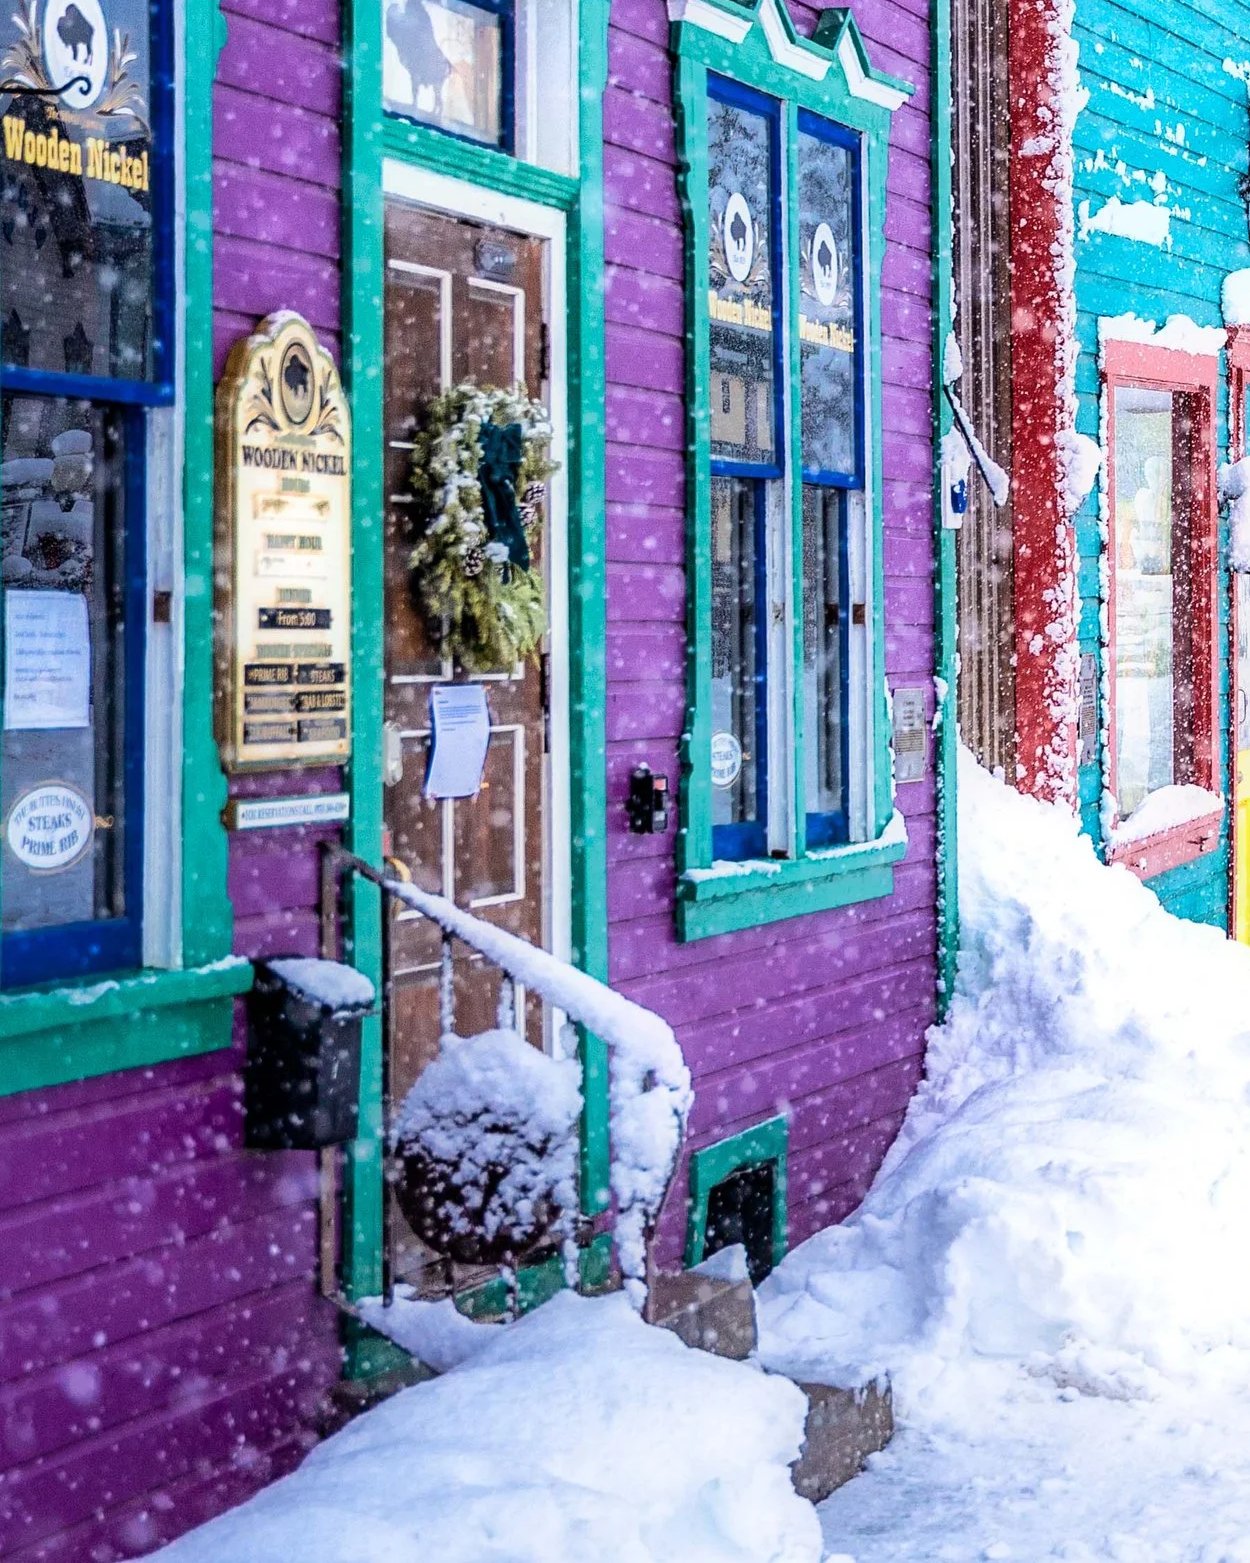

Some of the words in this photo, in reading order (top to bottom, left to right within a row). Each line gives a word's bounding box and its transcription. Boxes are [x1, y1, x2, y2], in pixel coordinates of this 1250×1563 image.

[3, 114, 82, 176] Wooden
[86, 136, 149, 192] Nickel
[707, 290, 742, 324] Wooden
[743, 298, 772, 331] Nickel
[242, 444, 298, 471] WOODEN
[301, 451, 347, 476] NICKEL
[28, 812, 72, 832] STEAKS
[20, 835, 57, 856] PRIME
[59, 829, 79, 852] RIB
